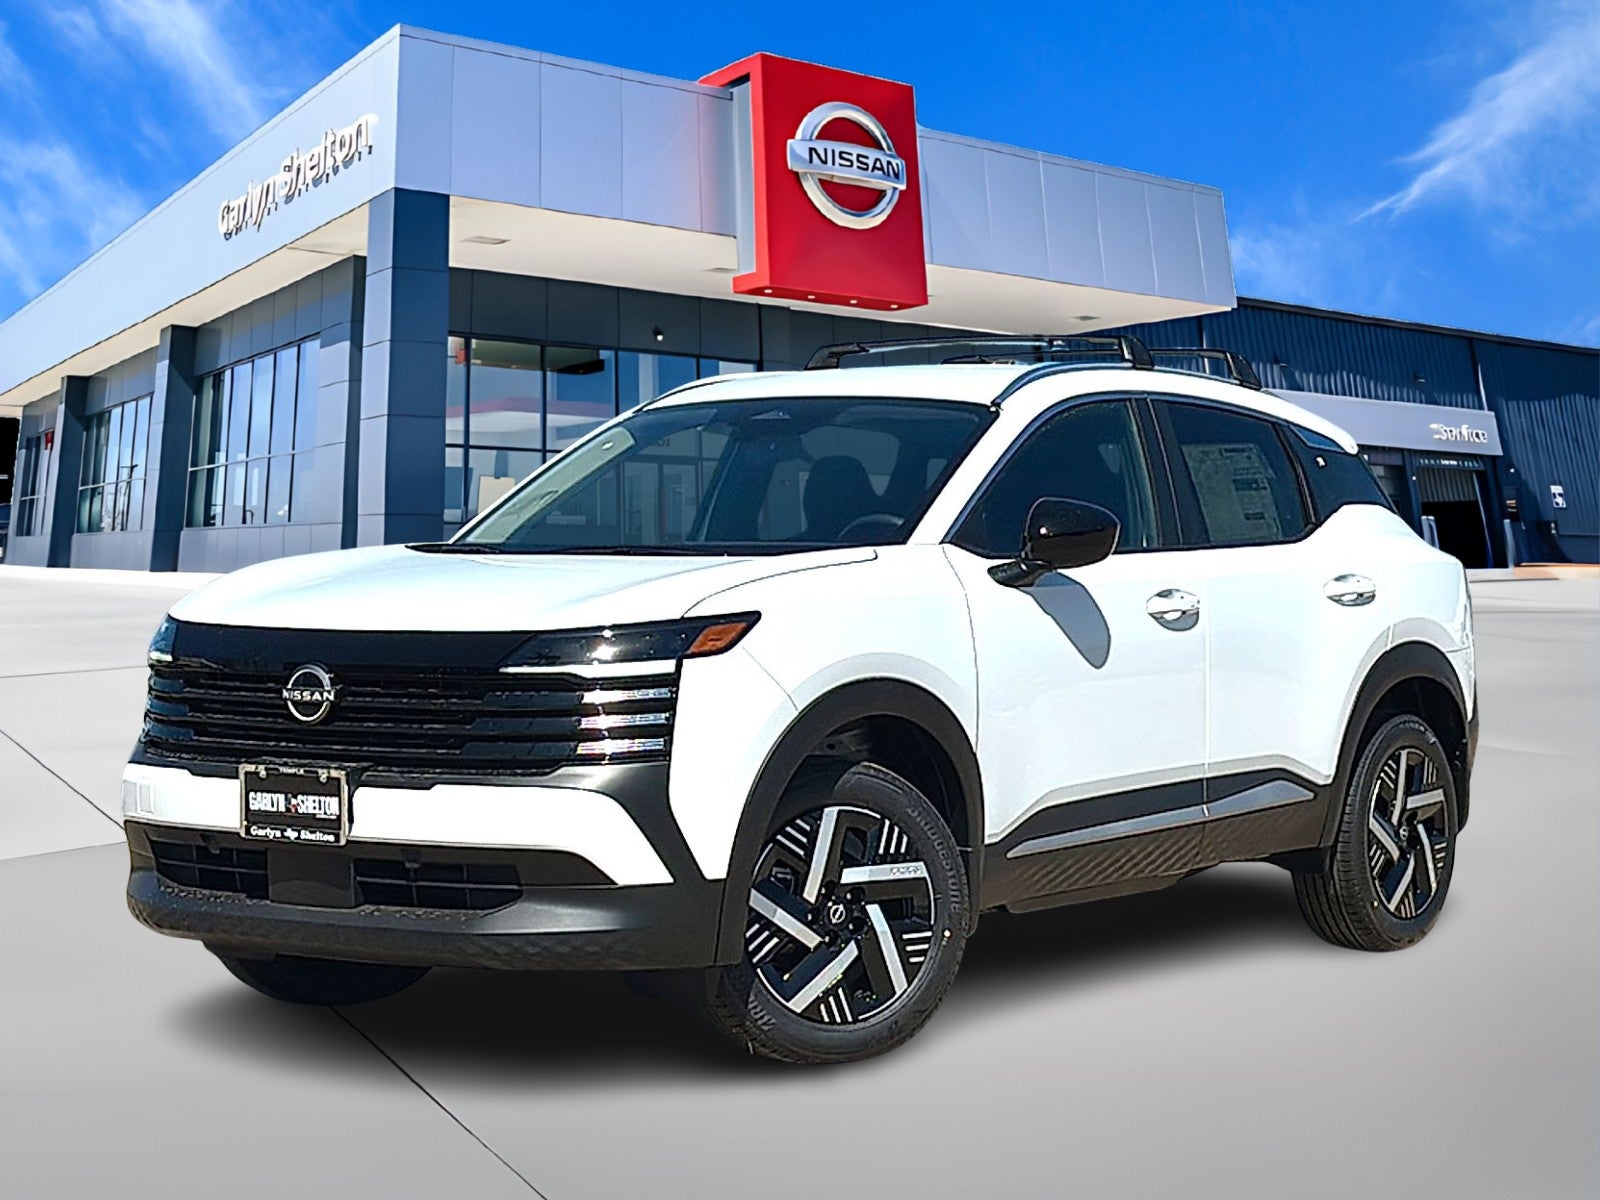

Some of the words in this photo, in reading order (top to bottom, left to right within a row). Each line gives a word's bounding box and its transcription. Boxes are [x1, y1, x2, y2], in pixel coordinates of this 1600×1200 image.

[218, 181, 278, 236] Garlyn
[278, 121, 373, 201] Shelton
[808, 146, 900, 181] NISSAN
[282, 689, 335, 701] NISSAN
[248, 791, 287, 812] GARLYN
[297, 794, 340, 816] SHELTON
